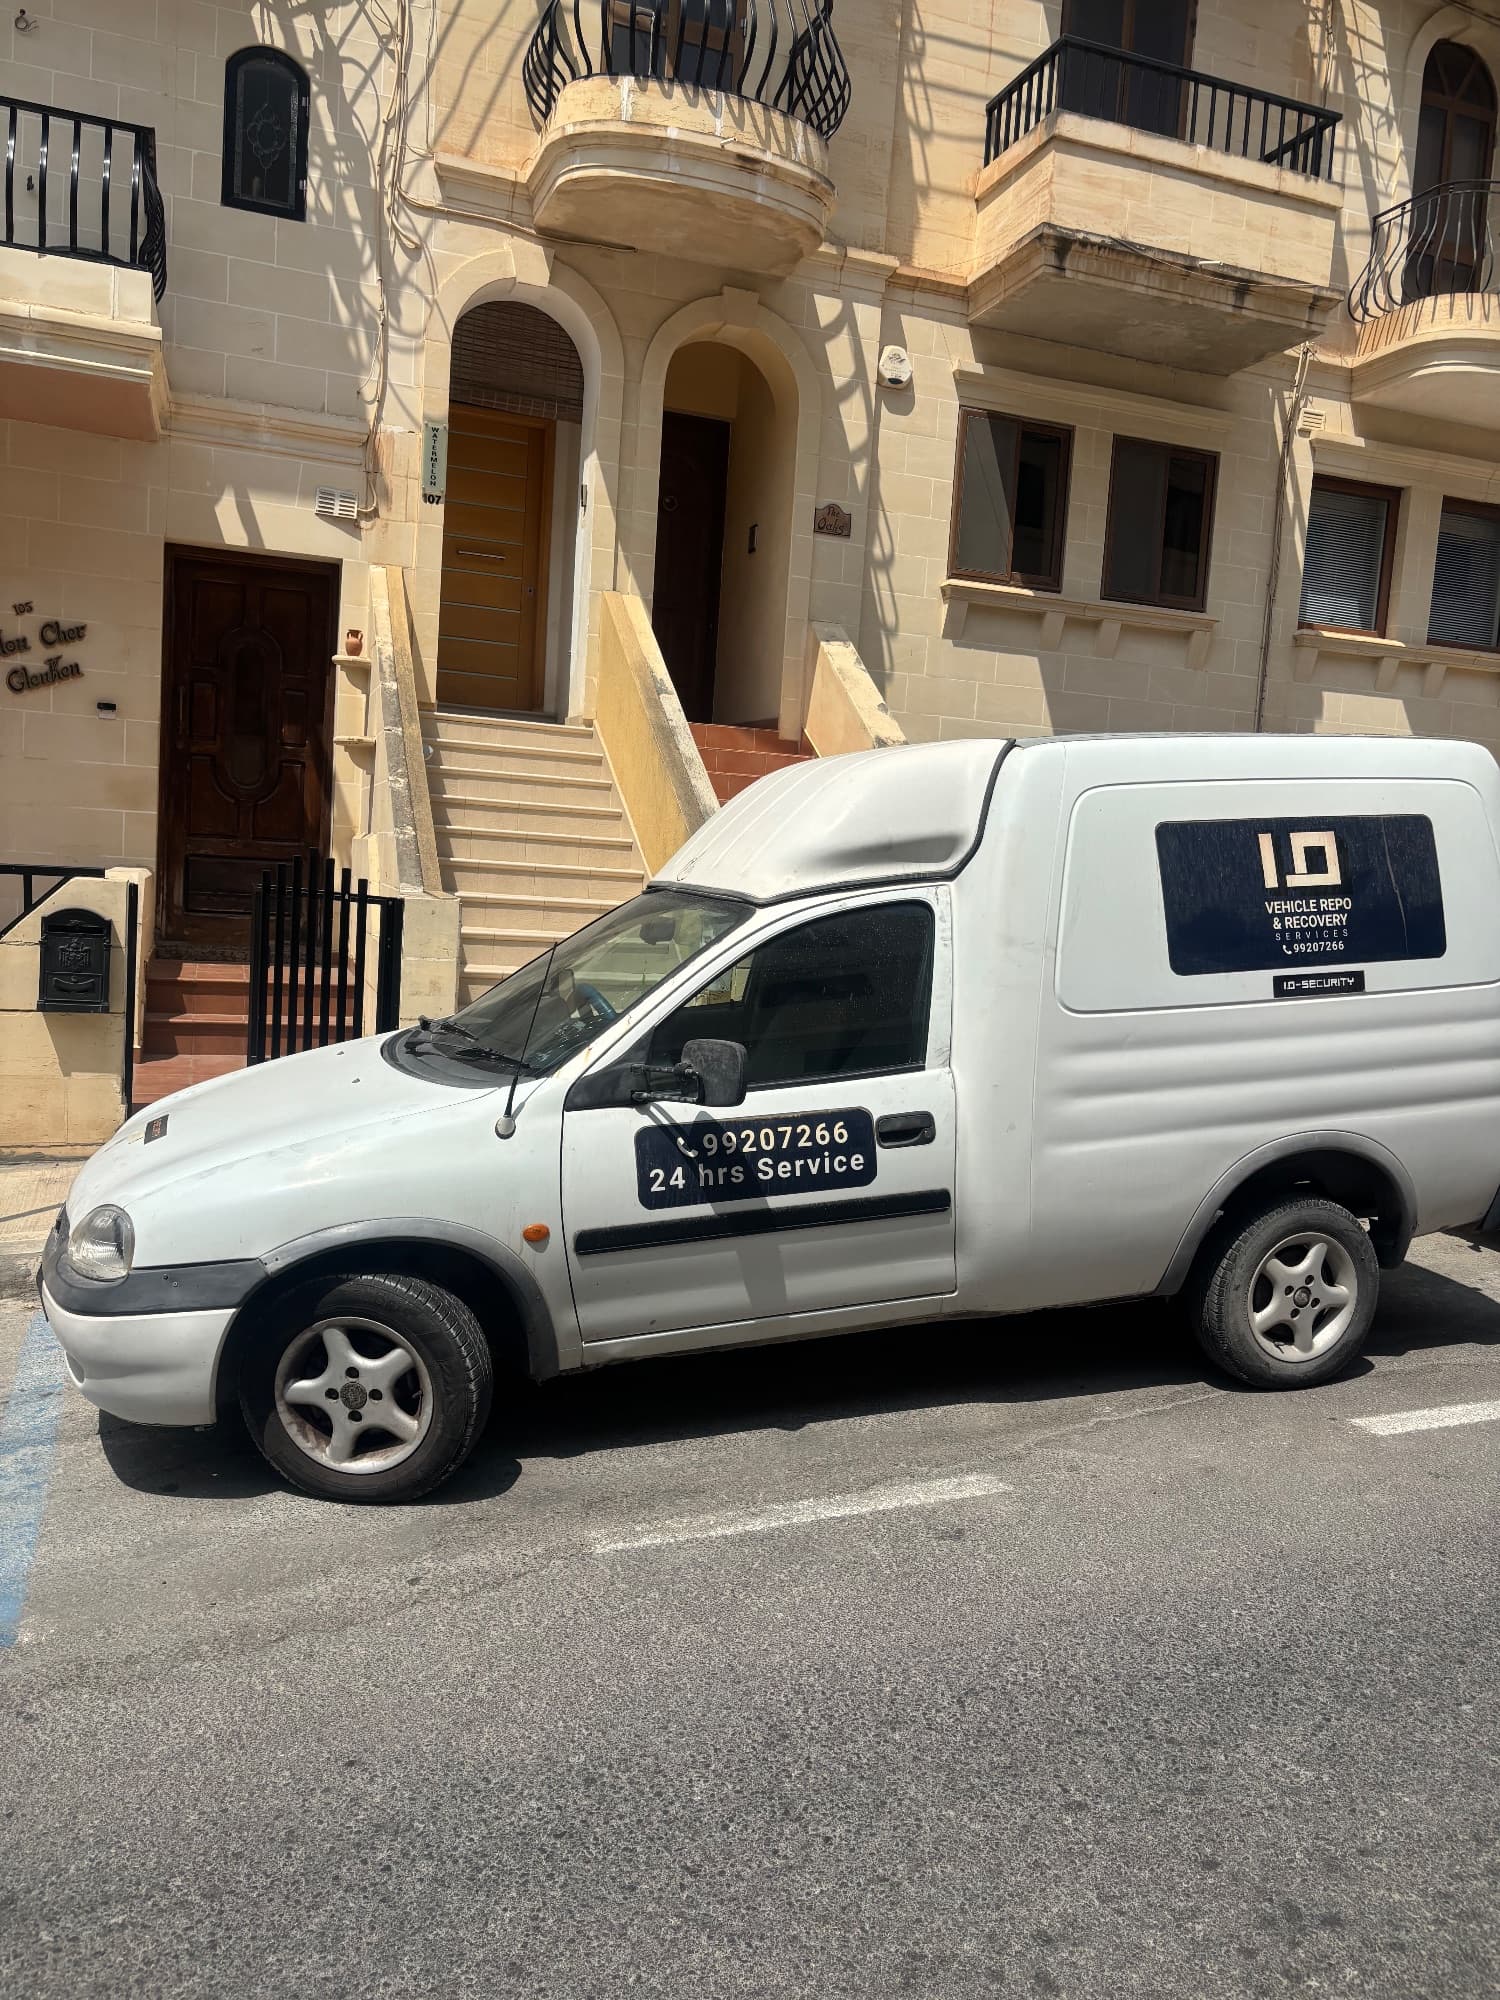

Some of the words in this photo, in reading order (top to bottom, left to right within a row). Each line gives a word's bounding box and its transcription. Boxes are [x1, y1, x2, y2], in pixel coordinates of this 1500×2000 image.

[430, 426, 440, 487] WATERMELON
[422, 493, 442, 505] 107
[12, 600, 34, 616] 105
[40, 620, 87, 647] Cher
[1265, 899, 1317, 914] VEHICLE
[1319, 897, 1352, 912] REPO
[1272, 916, 1282, 930] &
[1284, 913, 1348, 929] RECOVERY
[1275, 929, 1348, 941] SERVICES
[1293, 941, 1345, 953] 99207266
[702, 1121, 849, 1156] 99207266
[649, 1166, 686, 1193] 24
[699, 1163, 745, 1187] hrs
[757, 1151, 865, 1180] Service
